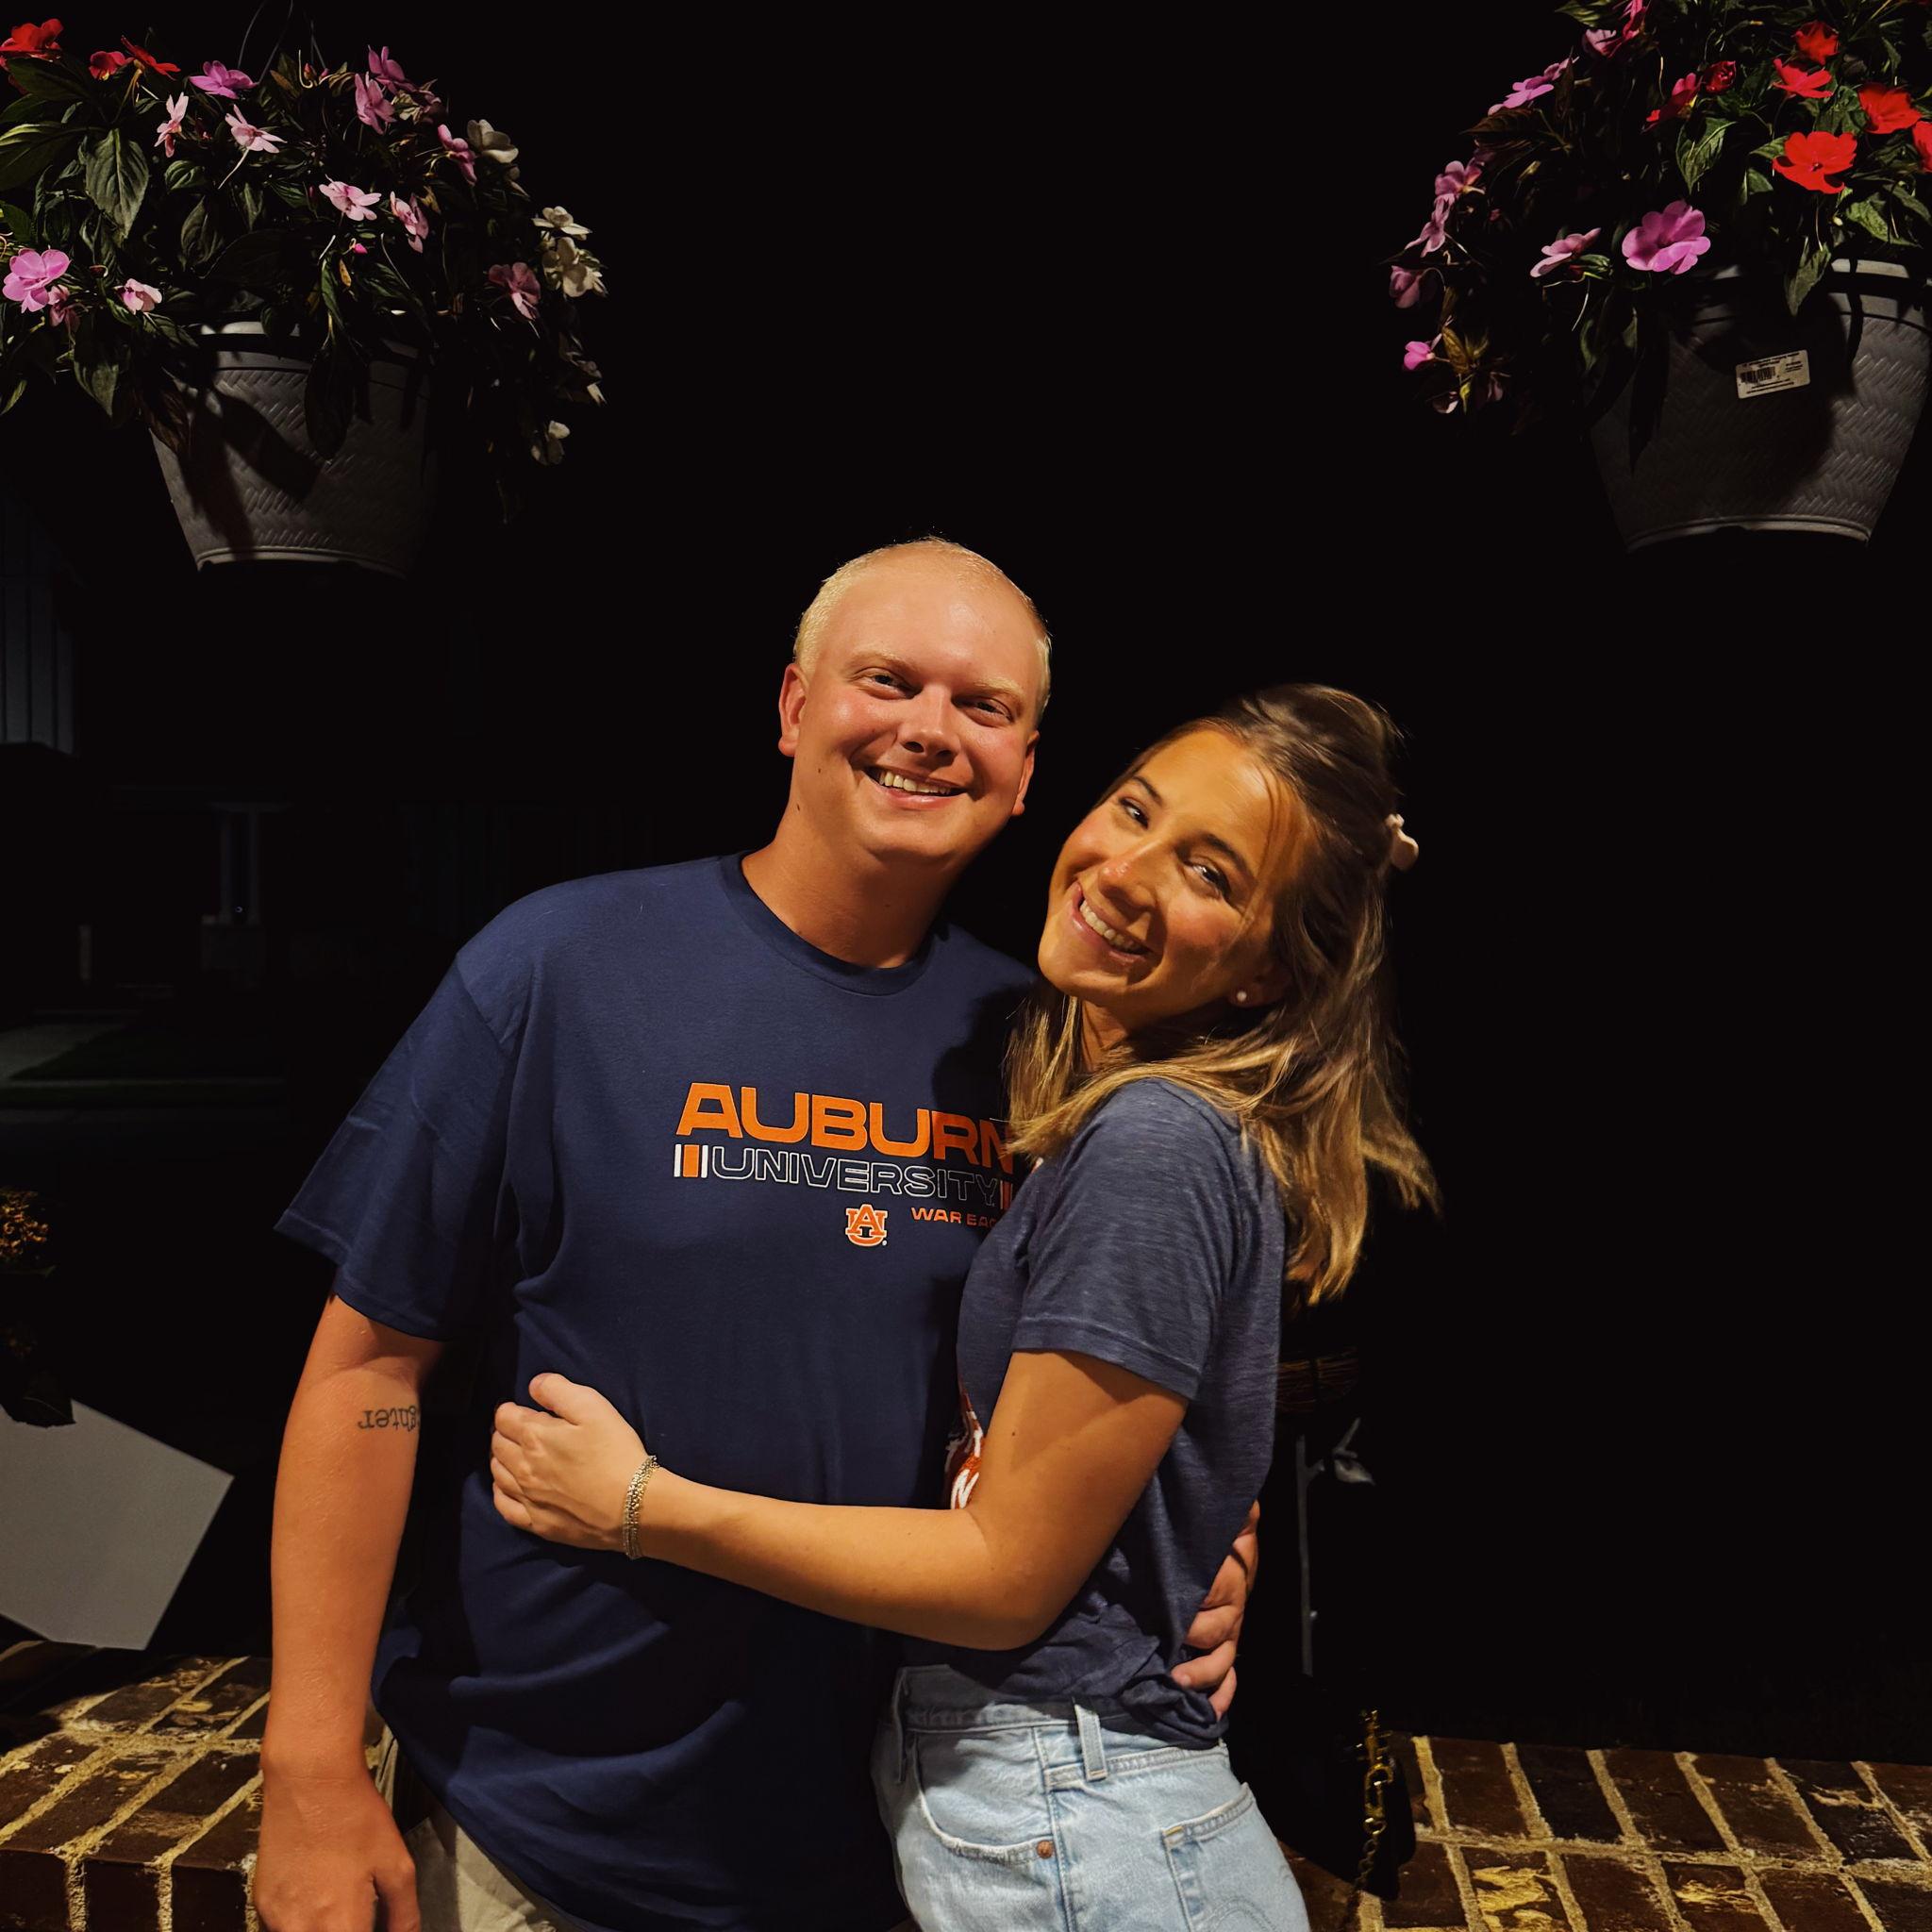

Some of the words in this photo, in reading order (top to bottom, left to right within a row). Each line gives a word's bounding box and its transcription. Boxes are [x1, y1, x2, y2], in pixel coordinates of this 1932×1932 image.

[675, 1082, 1013, 1174] AUBURN
[712, 1146, 997, 1208] UNIVERSITY
[911, 1207, 961, 1224] WAR
[358, 1405, 419, 1432] ghter
